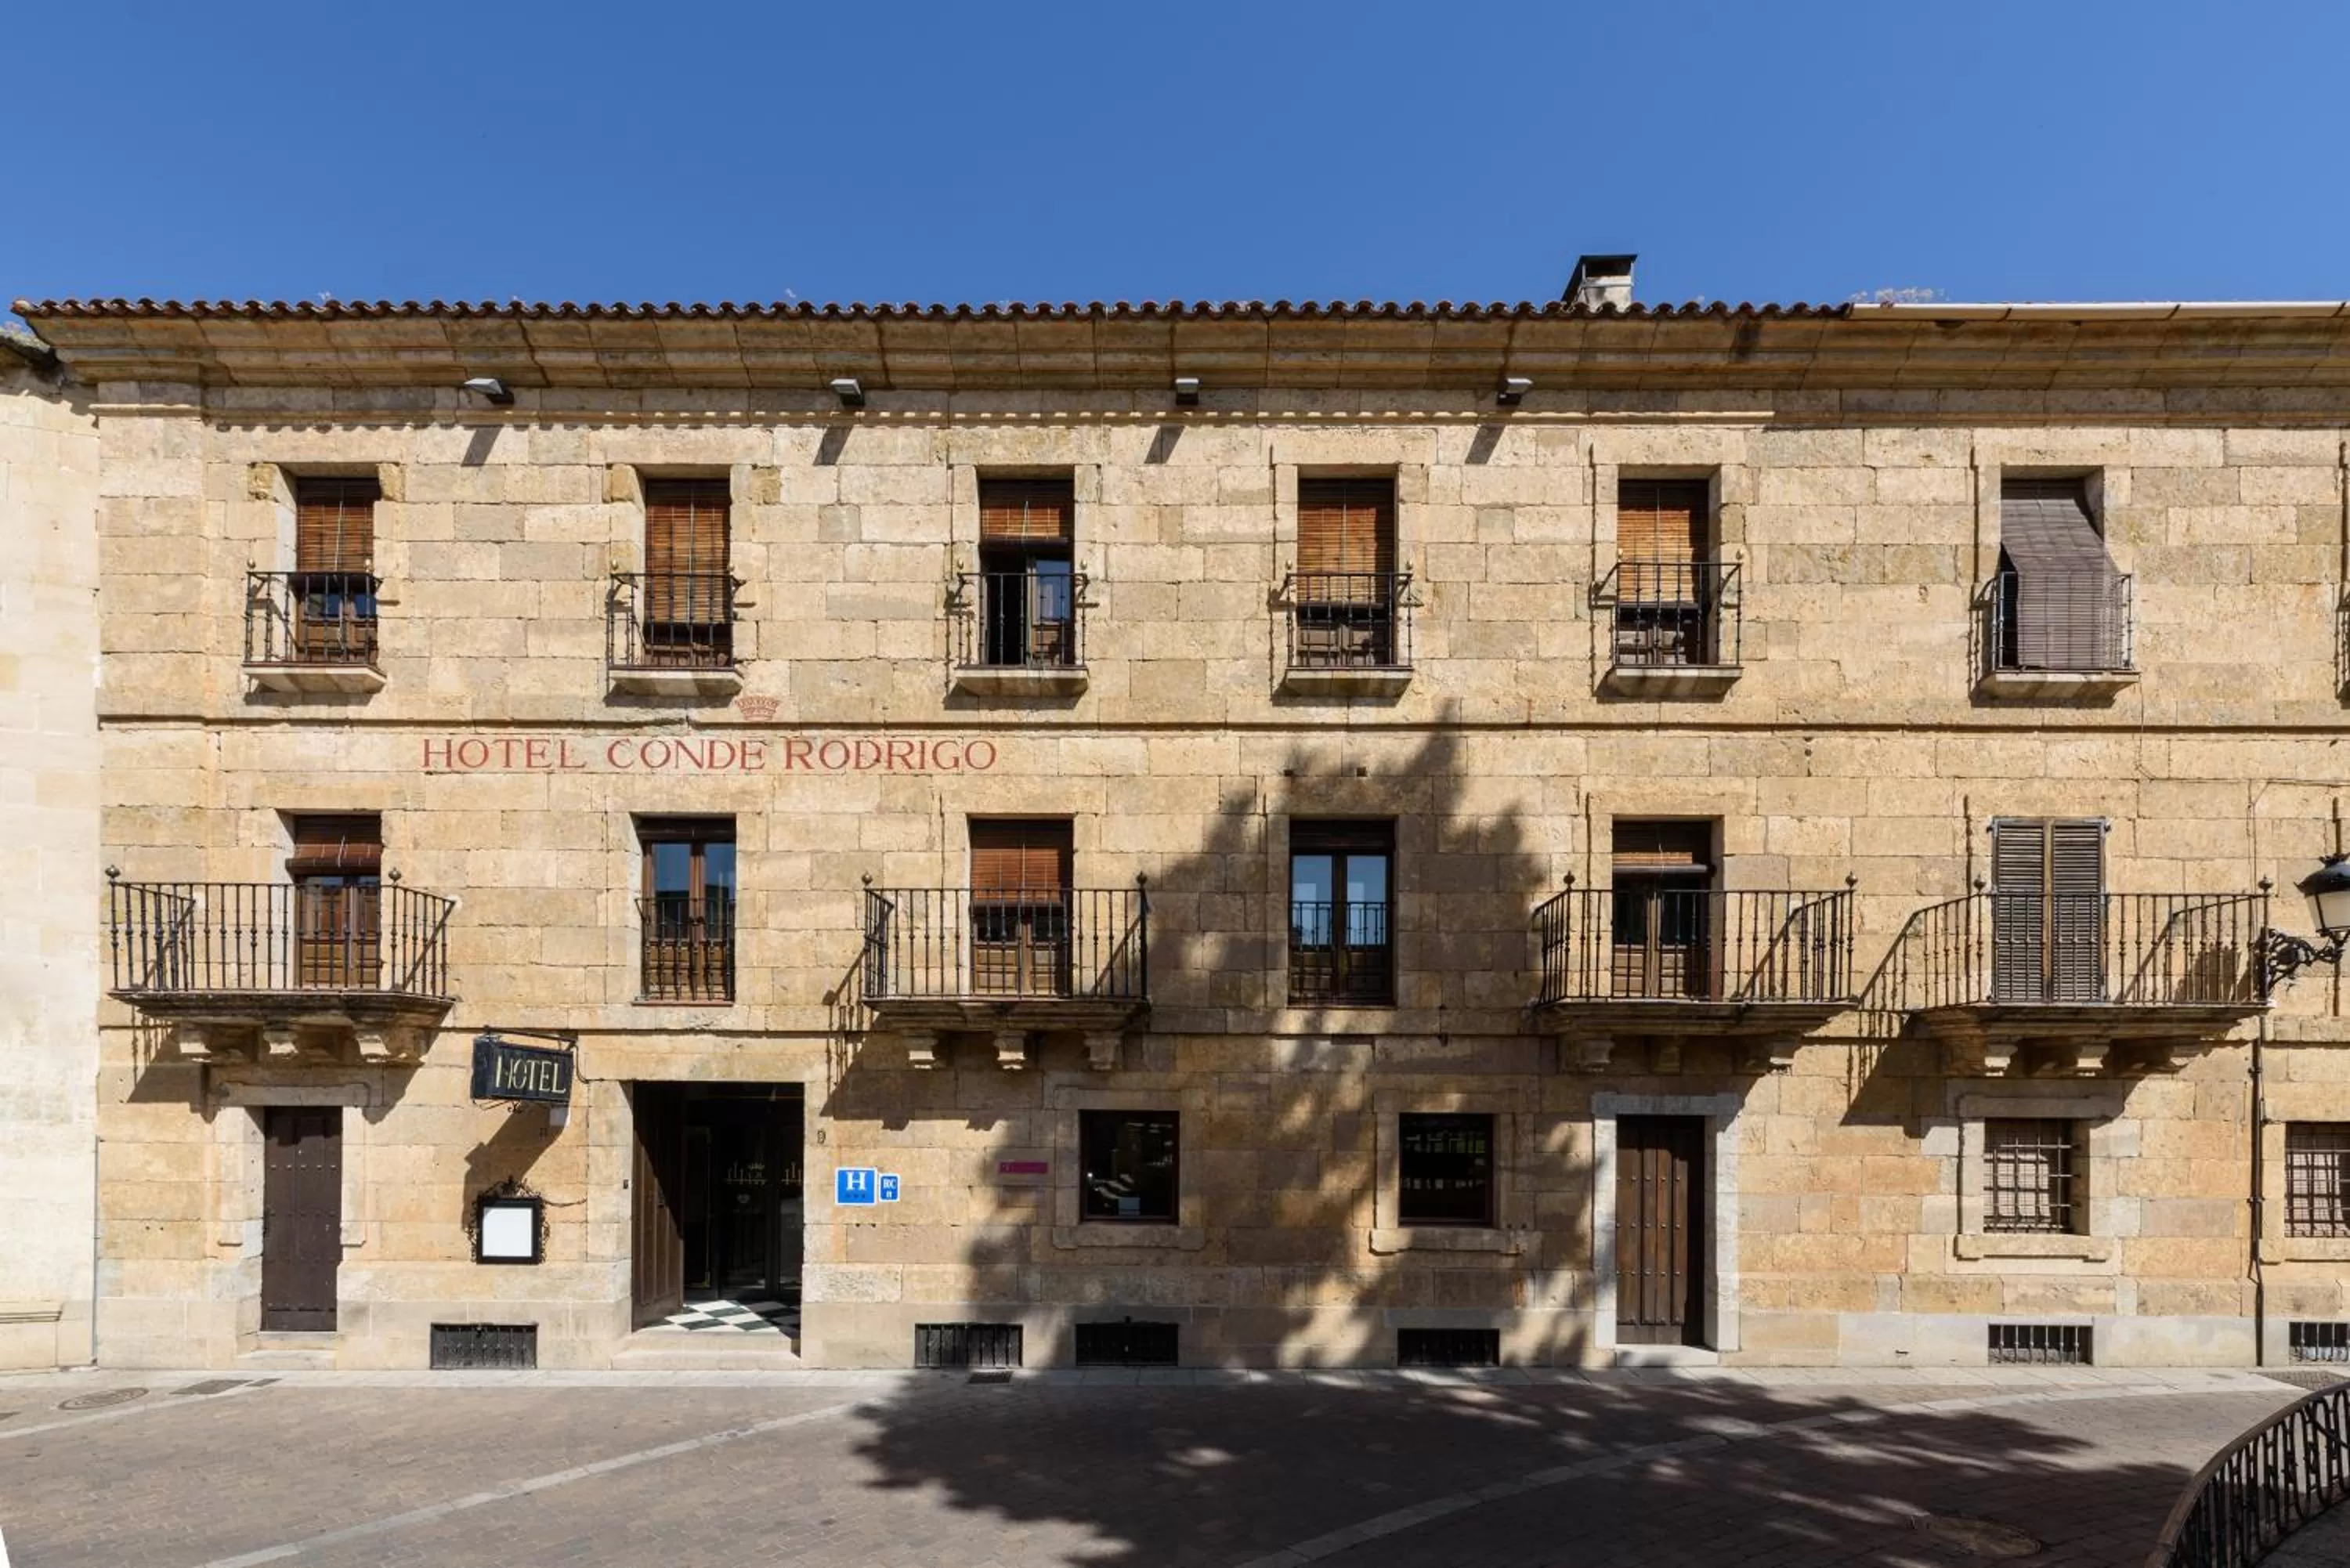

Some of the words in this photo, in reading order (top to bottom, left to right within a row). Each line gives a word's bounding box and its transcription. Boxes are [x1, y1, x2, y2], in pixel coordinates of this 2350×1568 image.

[421, 739, 587, 769] HOTEL
[606, 738, 765, 770] CONDE
[784, 739, 997, 771] RODRIGO
[495, 1055, 566, 1094] HOTEL
[846, 1171, 866, 1190] H
